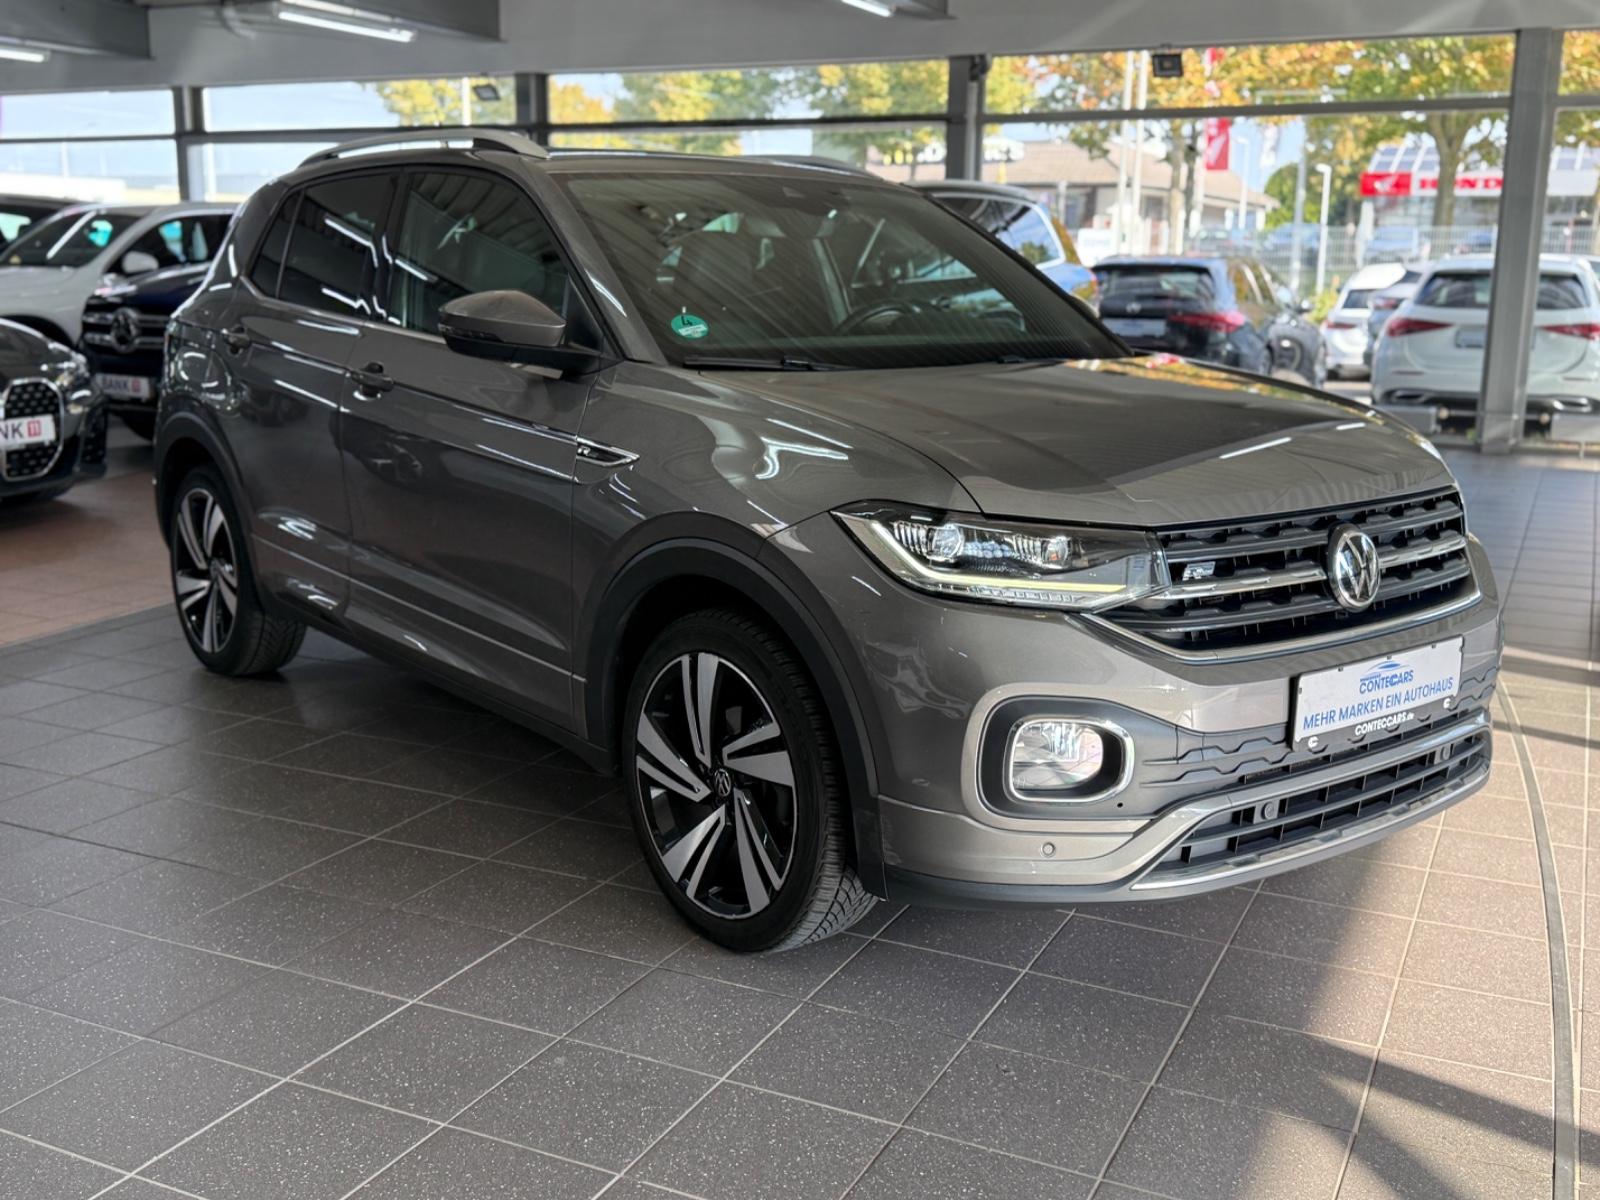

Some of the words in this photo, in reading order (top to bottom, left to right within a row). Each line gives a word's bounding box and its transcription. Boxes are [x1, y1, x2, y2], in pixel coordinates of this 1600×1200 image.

[1303, 709, 1337, 730] MEHR
[1338, 697, 1385, 721] MARKEN
[1386, 694, 1401, 709] EIN
[1403, 677, 1454, 703] AUTOHAUS
